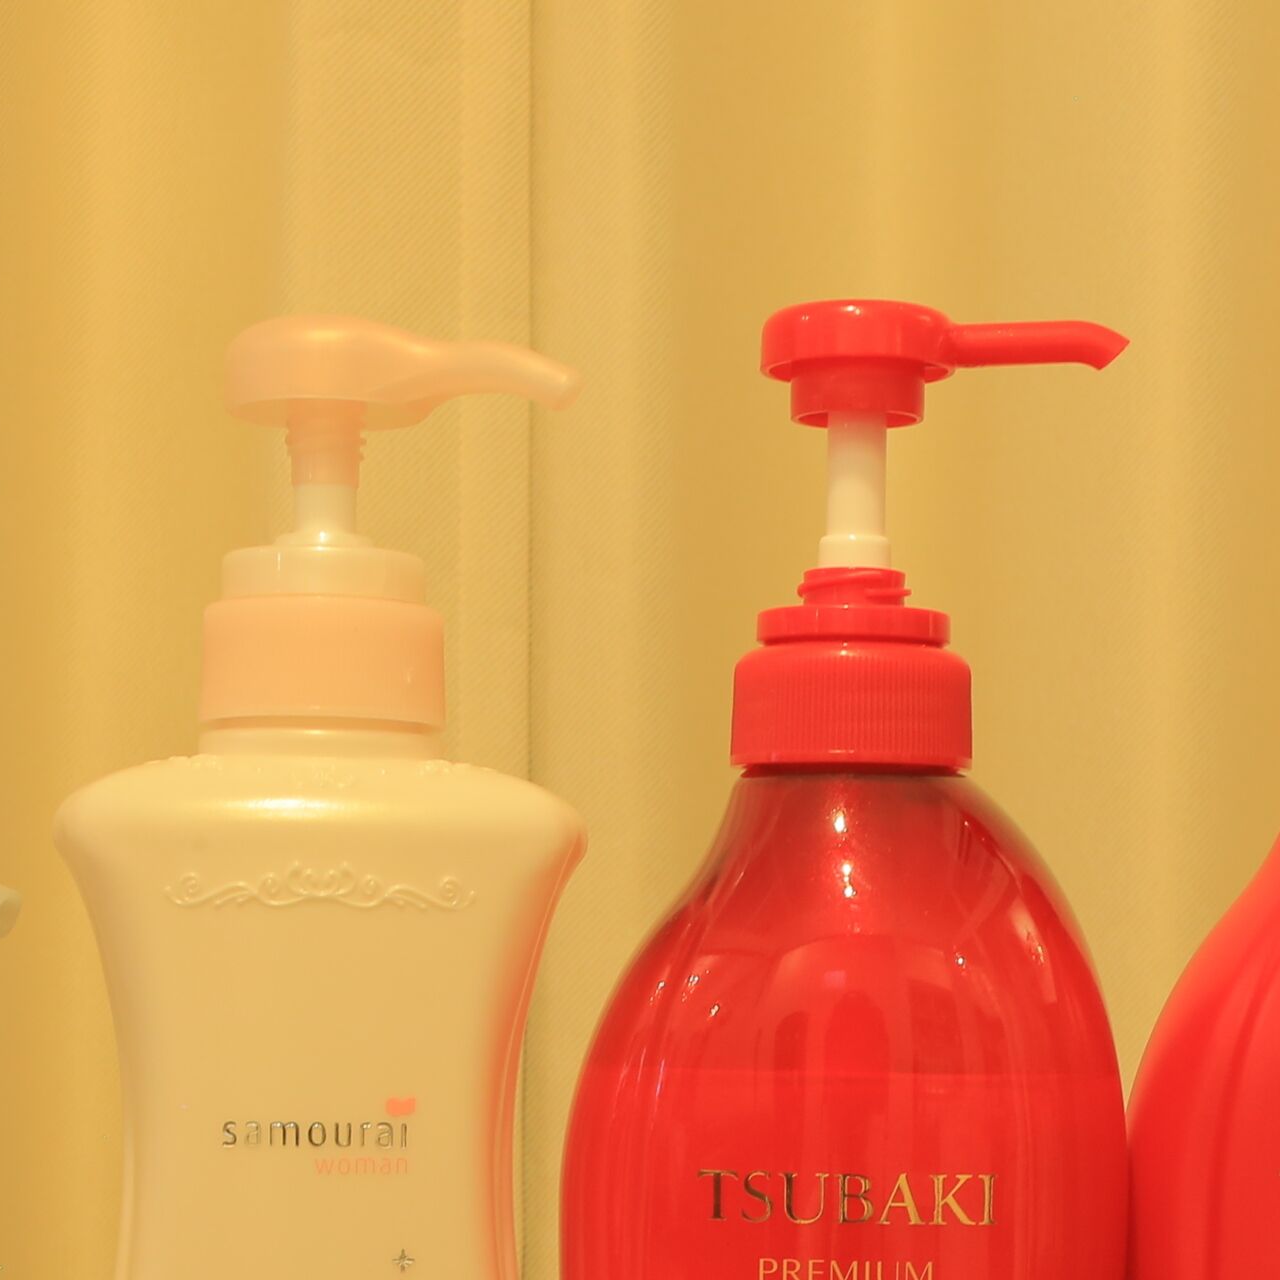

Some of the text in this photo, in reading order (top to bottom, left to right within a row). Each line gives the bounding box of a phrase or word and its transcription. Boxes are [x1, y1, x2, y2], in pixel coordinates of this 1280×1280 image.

[221, 1118, 410, 1149] samourai
[314, 1155, 409, 1176] woman
[697, 1169, 998, 1226] TSUBAKI
